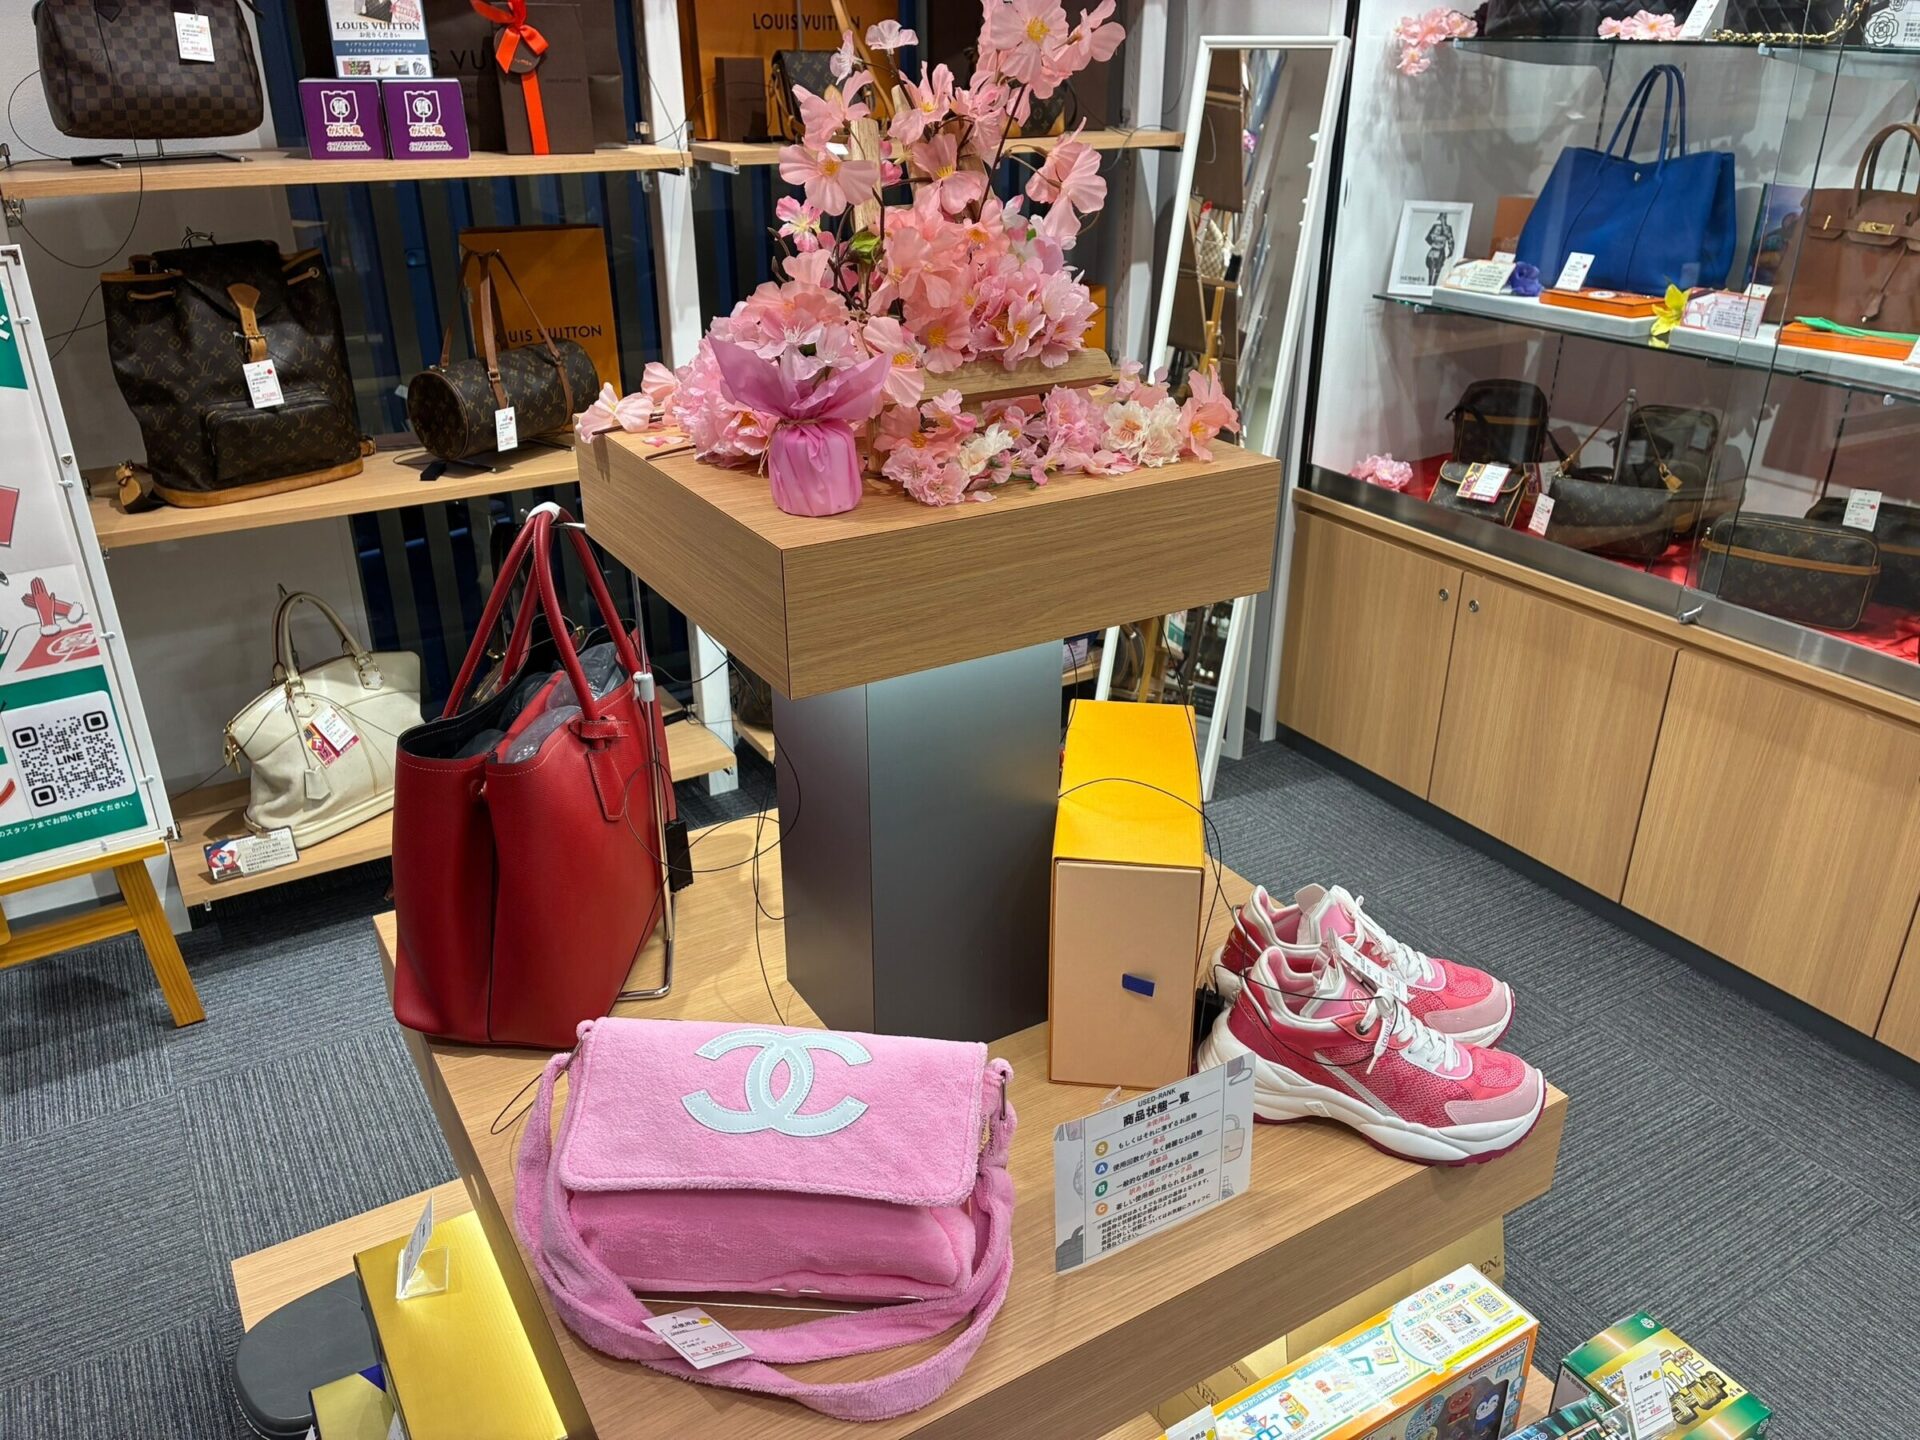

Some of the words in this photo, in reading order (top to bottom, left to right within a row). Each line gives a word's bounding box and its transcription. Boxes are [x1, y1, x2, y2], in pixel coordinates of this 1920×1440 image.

[336, 22, 369, 30] LOUIS
[371, 22, 420, 30] VUITTON
[753, 13, 798, 30] LOUIS
[802, 15, 860, 31] VUITTN
[495, 328, 533, 343] OUIS
[537, 324, 602, 340] VUITTON
[56, 751, 84, 766] LINE
[1138, 1088, 1176, 1107] USED-RANK
[1123, 1091, 1190, 1127] 商品状態一覧
[1118, 1111, 1196, 1149] もしくはそれに準ずるお品物
[1146, 1113, 1170, 1129] 未使用品
[1113, 1128, 1202, 1171] 使用回数が少なく綺麗なお品物
[1116, 1150, 1198, 1190] 一般的な使用感があるお品物
[1116, 1167, 1204, 1211] 著しい使用感の見られるお品物
[1498, 1341, 1526, 1361] NAMCO
